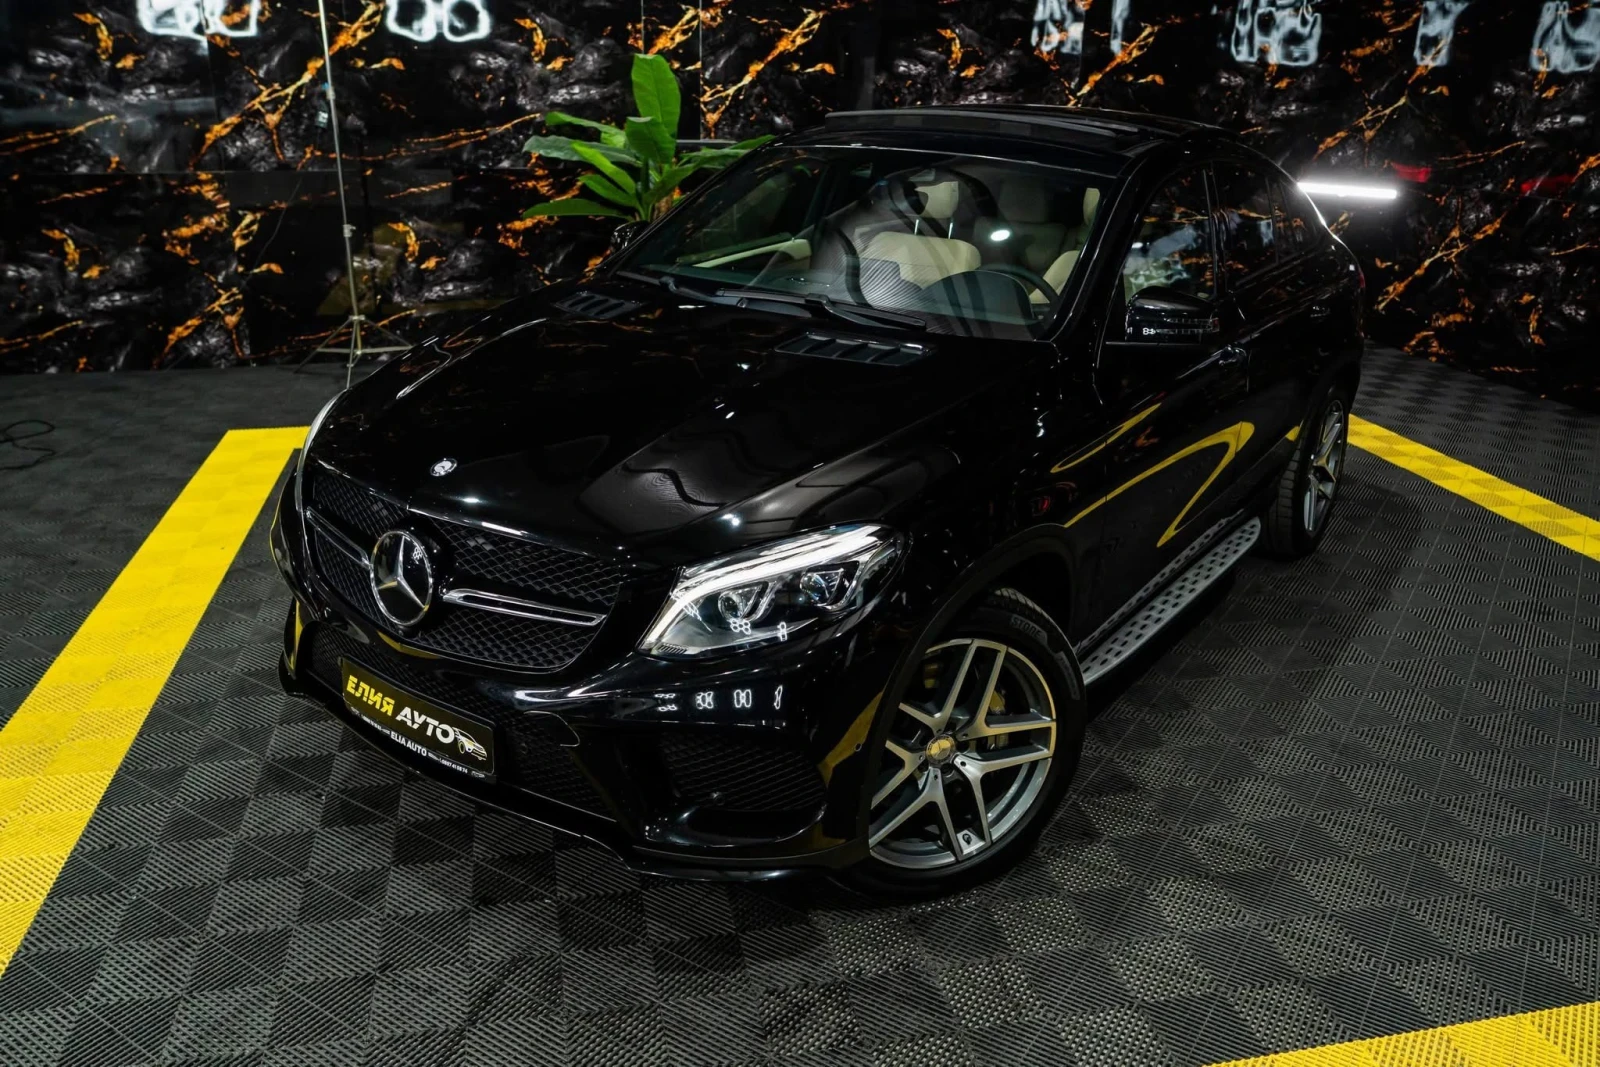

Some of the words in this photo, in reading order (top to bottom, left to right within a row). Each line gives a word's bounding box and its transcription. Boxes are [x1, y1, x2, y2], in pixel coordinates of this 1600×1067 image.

[346, 674, 395, 716] ЕЛИЯ
[395, 706, 455, 744] АУТО
[390, 731, 407, 746] ELIA
[407, 740, 427, 756] AUTO
